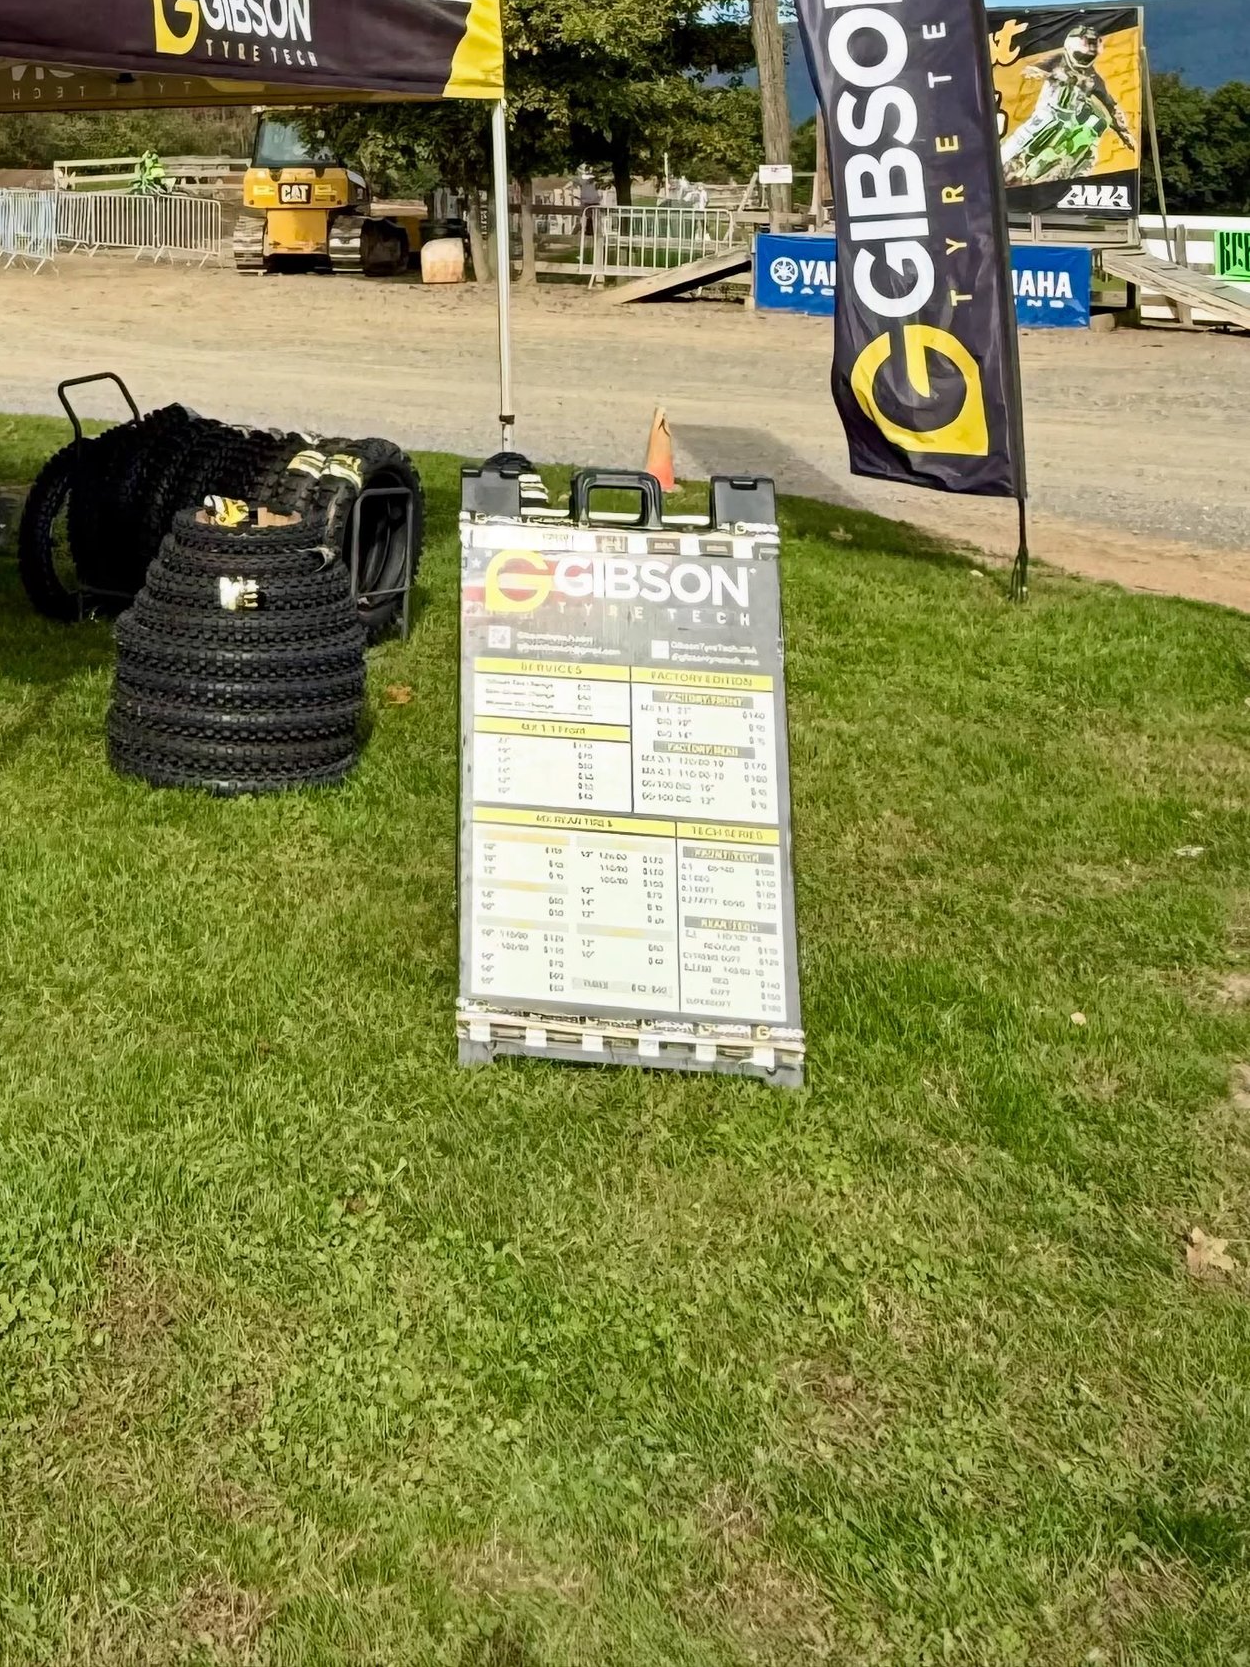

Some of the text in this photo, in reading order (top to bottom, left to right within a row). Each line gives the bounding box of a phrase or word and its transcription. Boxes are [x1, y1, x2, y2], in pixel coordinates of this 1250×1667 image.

[205, 38, 319, 67] TYRE TECH
[281, 184, 309, 203] CAT
[1057, 184, 1132, 209] AMA
[935, 134, 973, 307] TYRE
[554, 555, 750, 608] GIBSON
[559, 602, 751, 627] TYRE TECH
[650, 671, 753, 687] FACTORY EDITION
